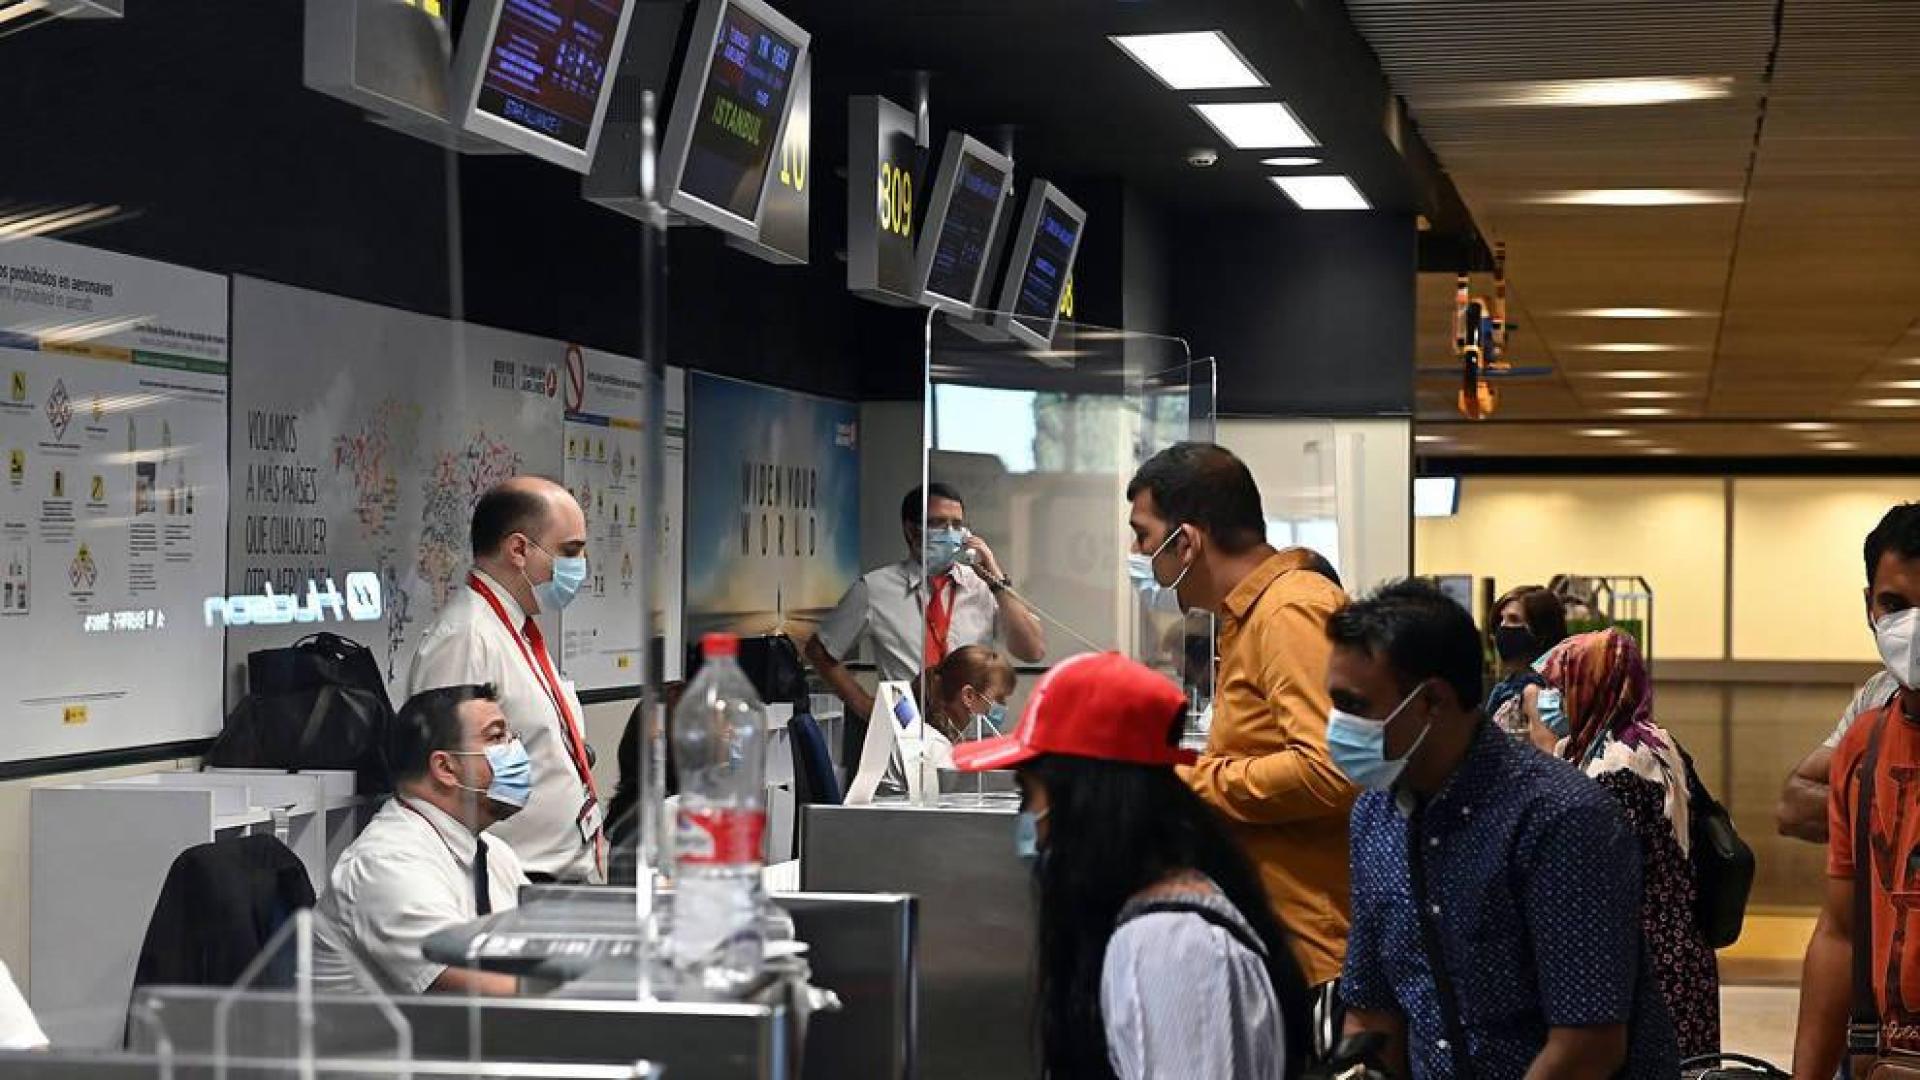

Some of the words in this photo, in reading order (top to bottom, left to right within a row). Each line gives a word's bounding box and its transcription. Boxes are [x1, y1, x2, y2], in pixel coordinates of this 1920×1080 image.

[247, 410, 297, 453] VOLAMOS
[246, 465, 255, 502] A
[741, 463, 782, 508] WIDEN
[787, 466, 816, 510] YOUR
[246, 515, 268, 555] QUE
[270, 516, 327, 556] CUALQUIER
[740, 513, 815, 557] WORLD
